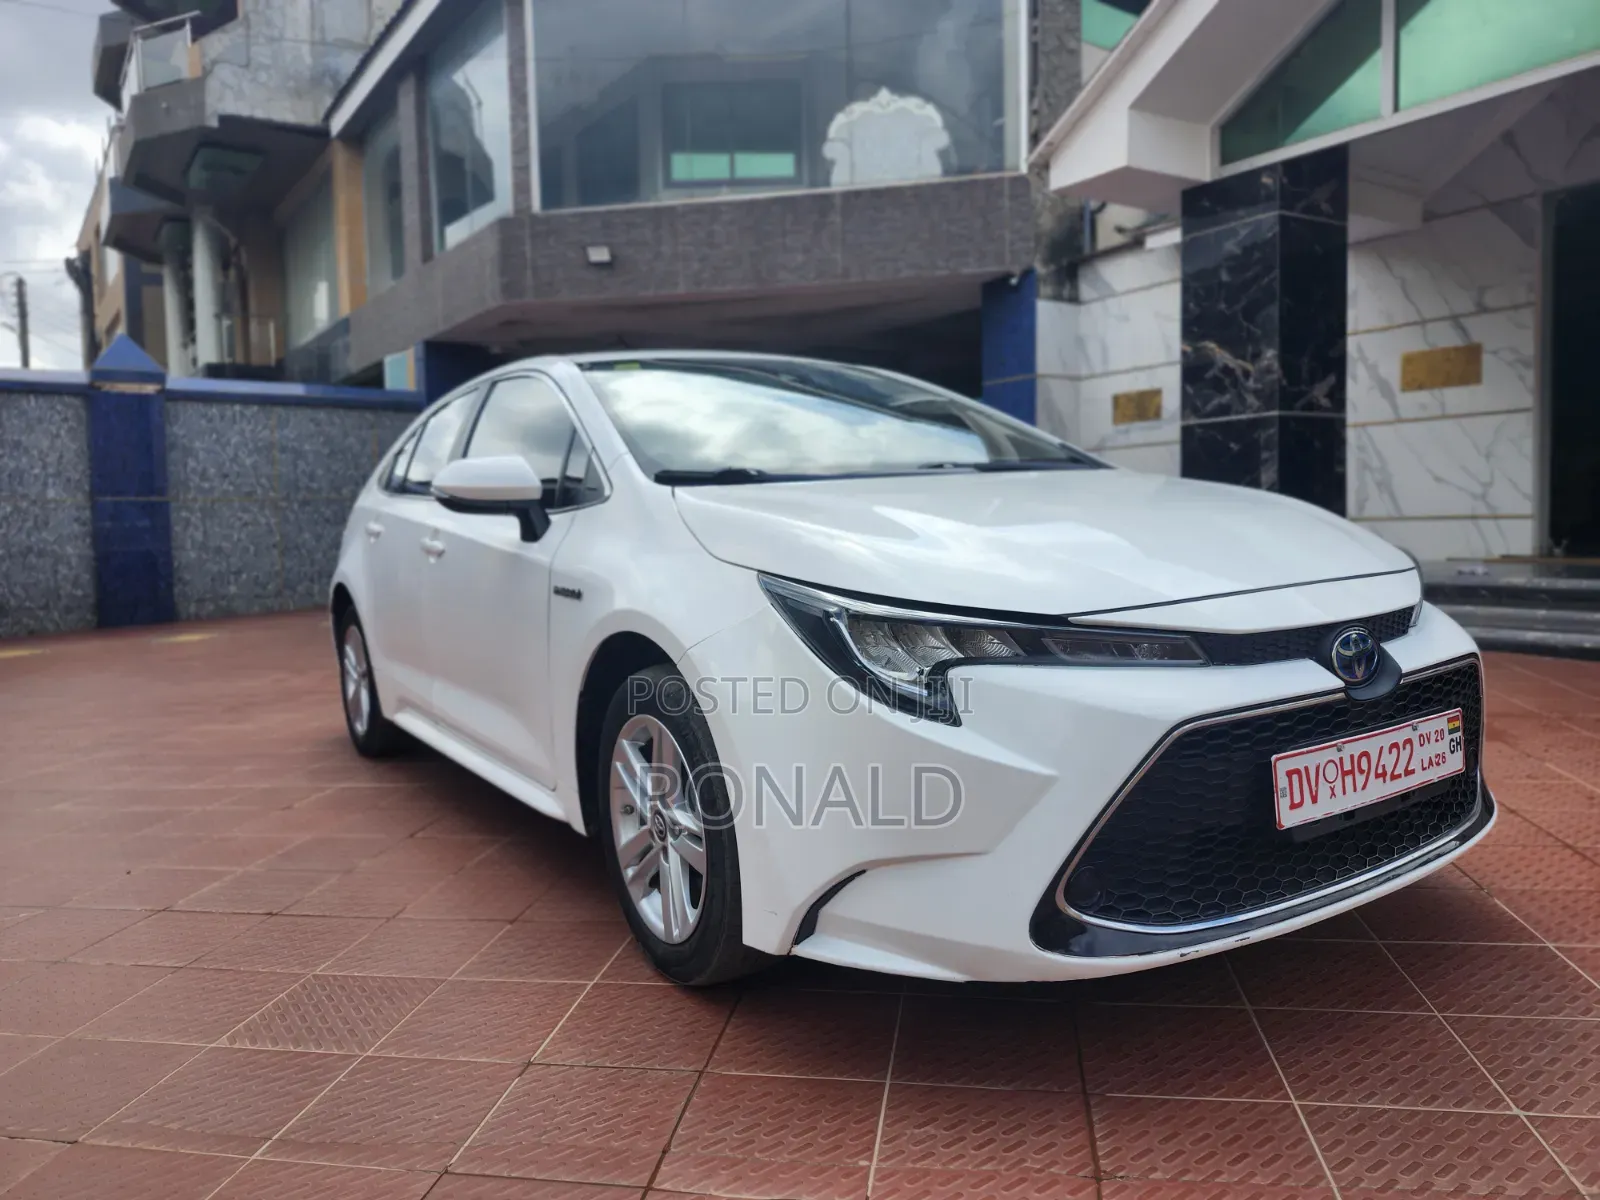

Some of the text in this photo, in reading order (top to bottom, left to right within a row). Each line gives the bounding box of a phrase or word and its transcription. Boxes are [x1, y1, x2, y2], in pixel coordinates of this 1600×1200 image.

[1418, 727, 1445, 748] DV 20
[1448, 735, 1463, 755] GH
